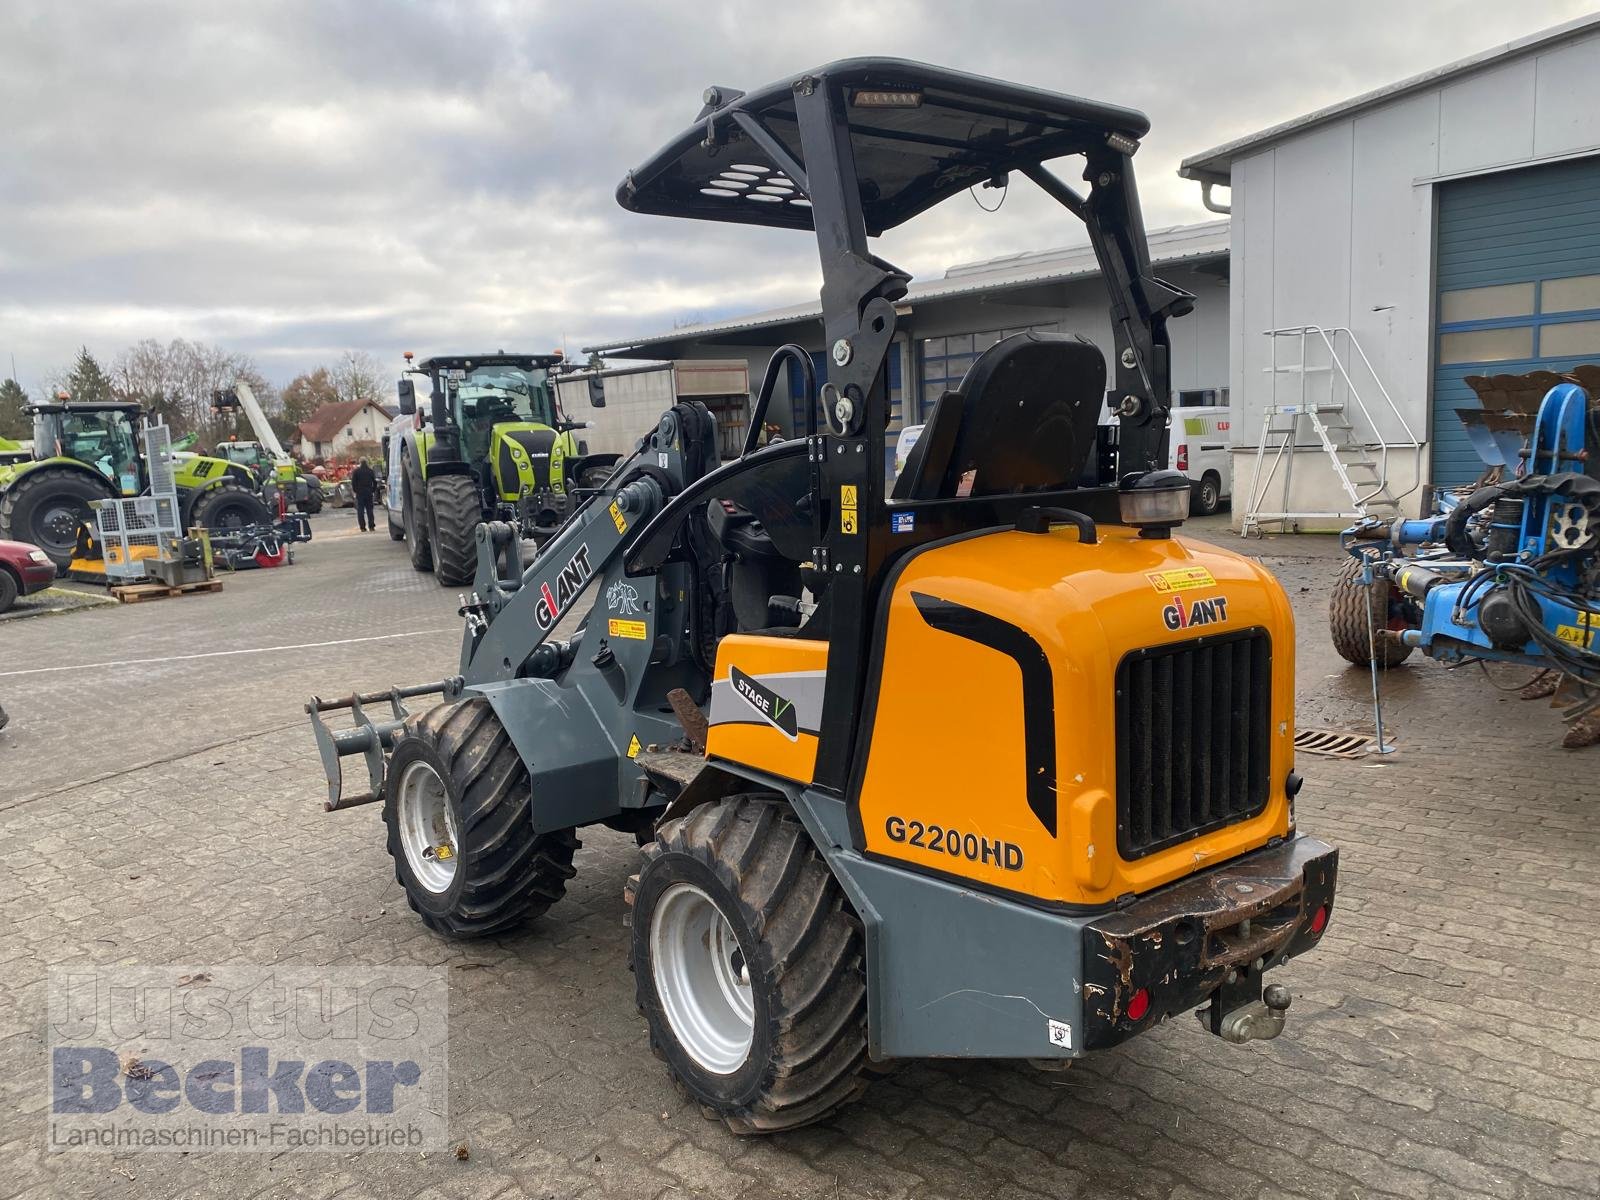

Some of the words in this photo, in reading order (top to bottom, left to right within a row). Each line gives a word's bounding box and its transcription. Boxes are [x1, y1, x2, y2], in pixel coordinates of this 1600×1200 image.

[738, 679, 770, 713] STAGE
[774, 696, 792, 721] V
[885, 815, 1024, 872] G2200HD
